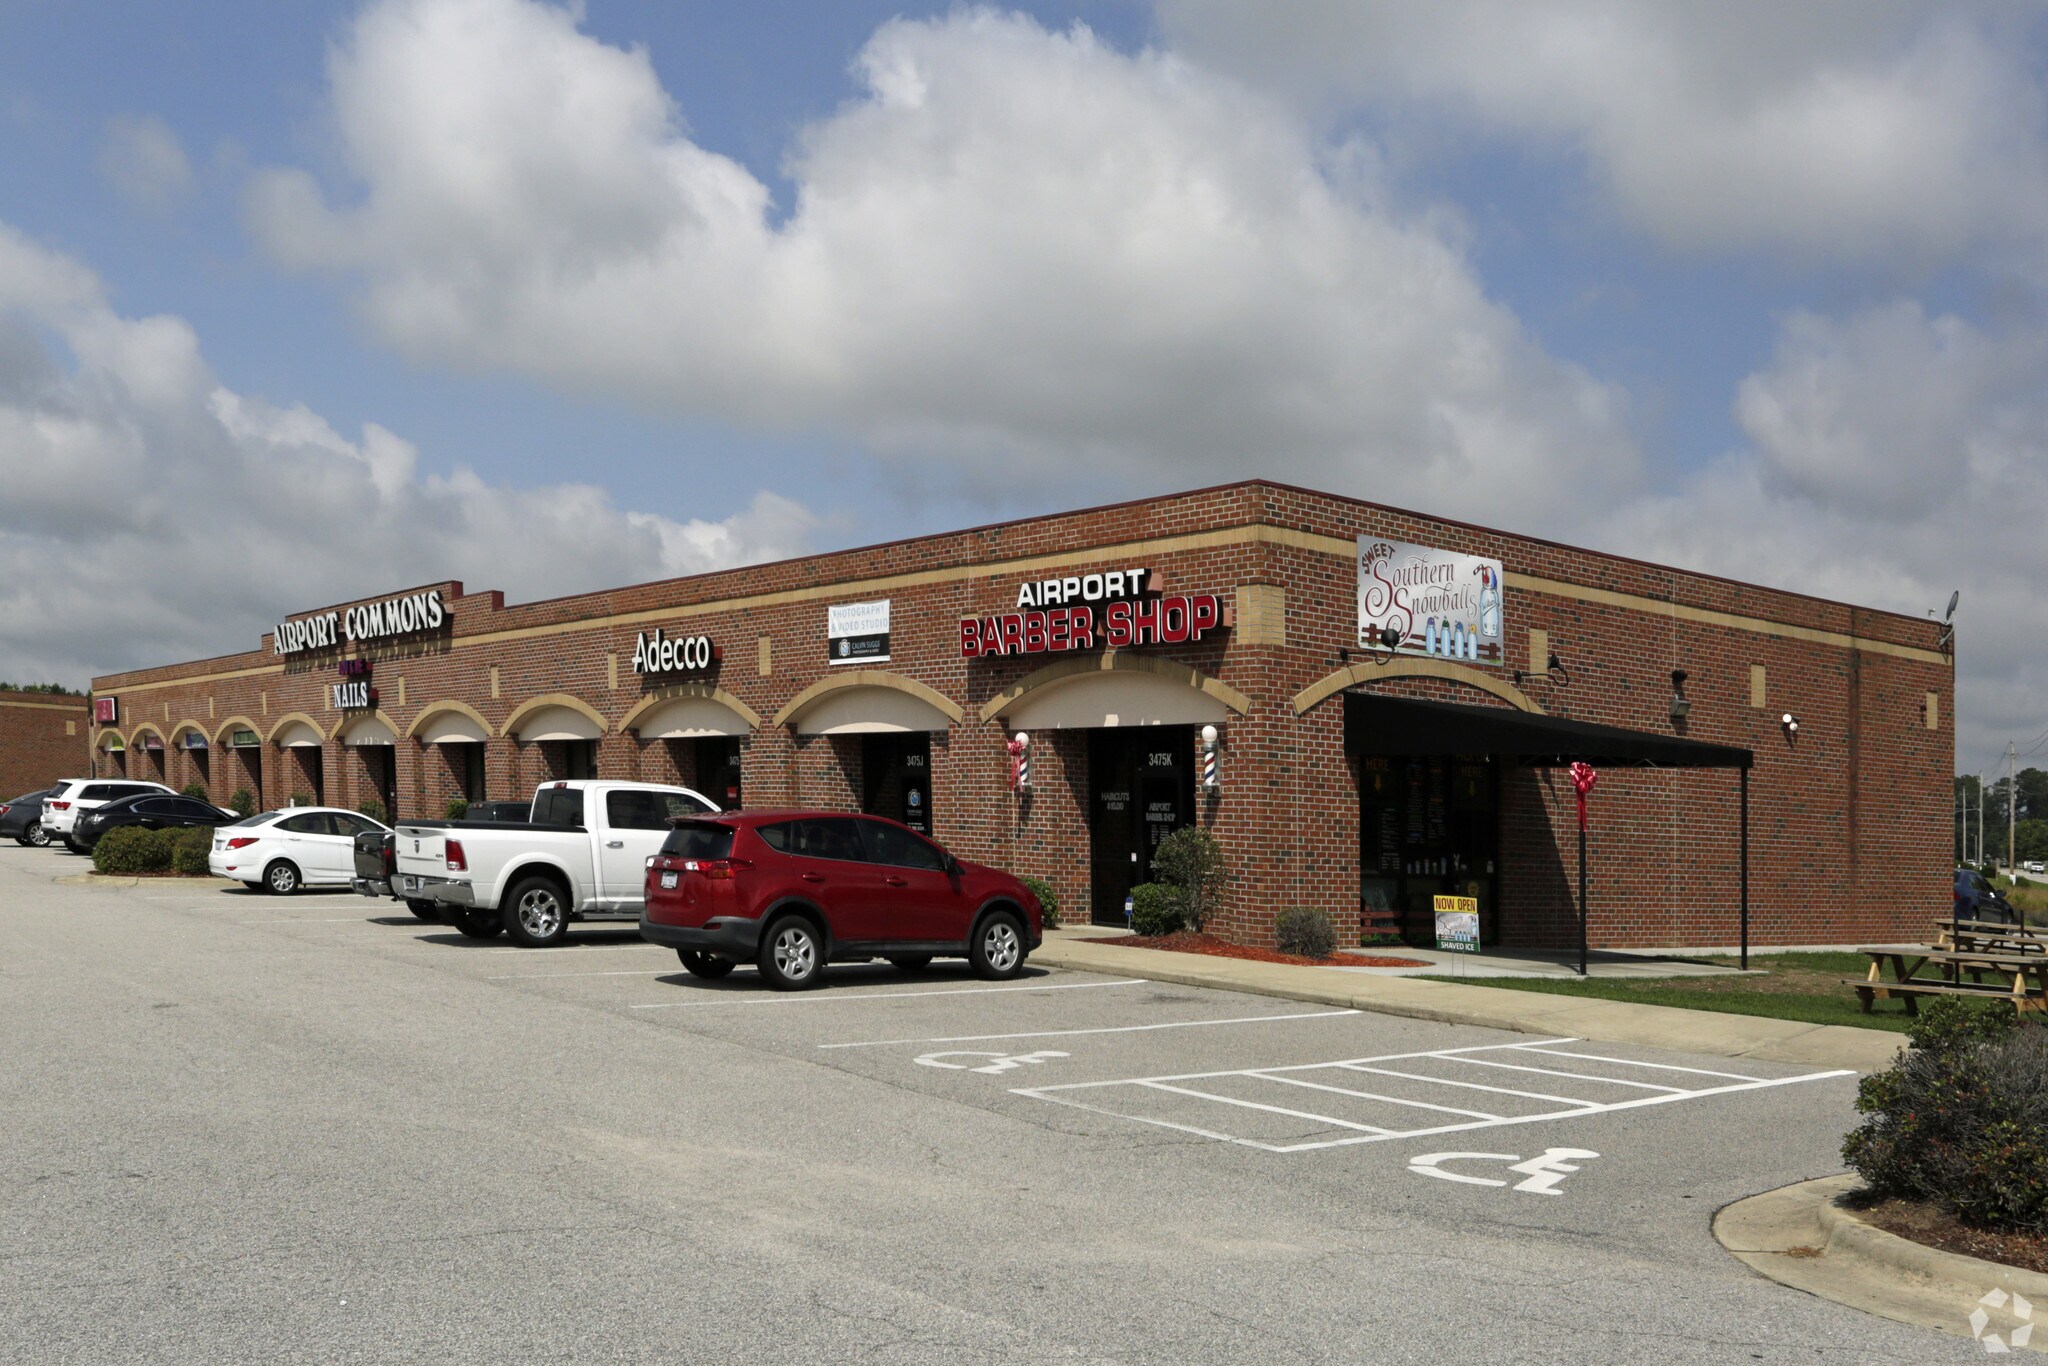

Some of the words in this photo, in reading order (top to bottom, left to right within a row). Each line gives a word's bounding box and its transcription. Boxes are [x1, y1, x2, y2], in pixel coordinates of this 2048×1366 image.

[1361, 542, 1396, 575] SWEET
[1016, 568, 1147, 609] AIRPORT
[1365, 553, 1455, 618] Southern
[274, 611, 339, 656] AIRPORT
[345, 590, 444, 641] COMMONS
[832, 604, 885, 619] PHOTOGRAPHY
[837, 621, 859, 632] VIDEO
[861, 617, 888, 630] STUDIO
[960, 605, 1094, 659] BARBER
[1106, 594, 1219, 647] SHOP
[1386, 583, 1478, 646] Snowballs
[632, 628, 710, 673] Adecco
[333, 681, 368, 708] NAILS
[906, 755, 924, 767] 3475J
[1148, 753, 1173, 767] 3475K
[1435, 897, 1455, 910] NOW
[1457, 898, 1476, 912] OPEN
[1440, 941, 1465, 951] SHAVED
[1465, 943, 1475, 951] ICE
